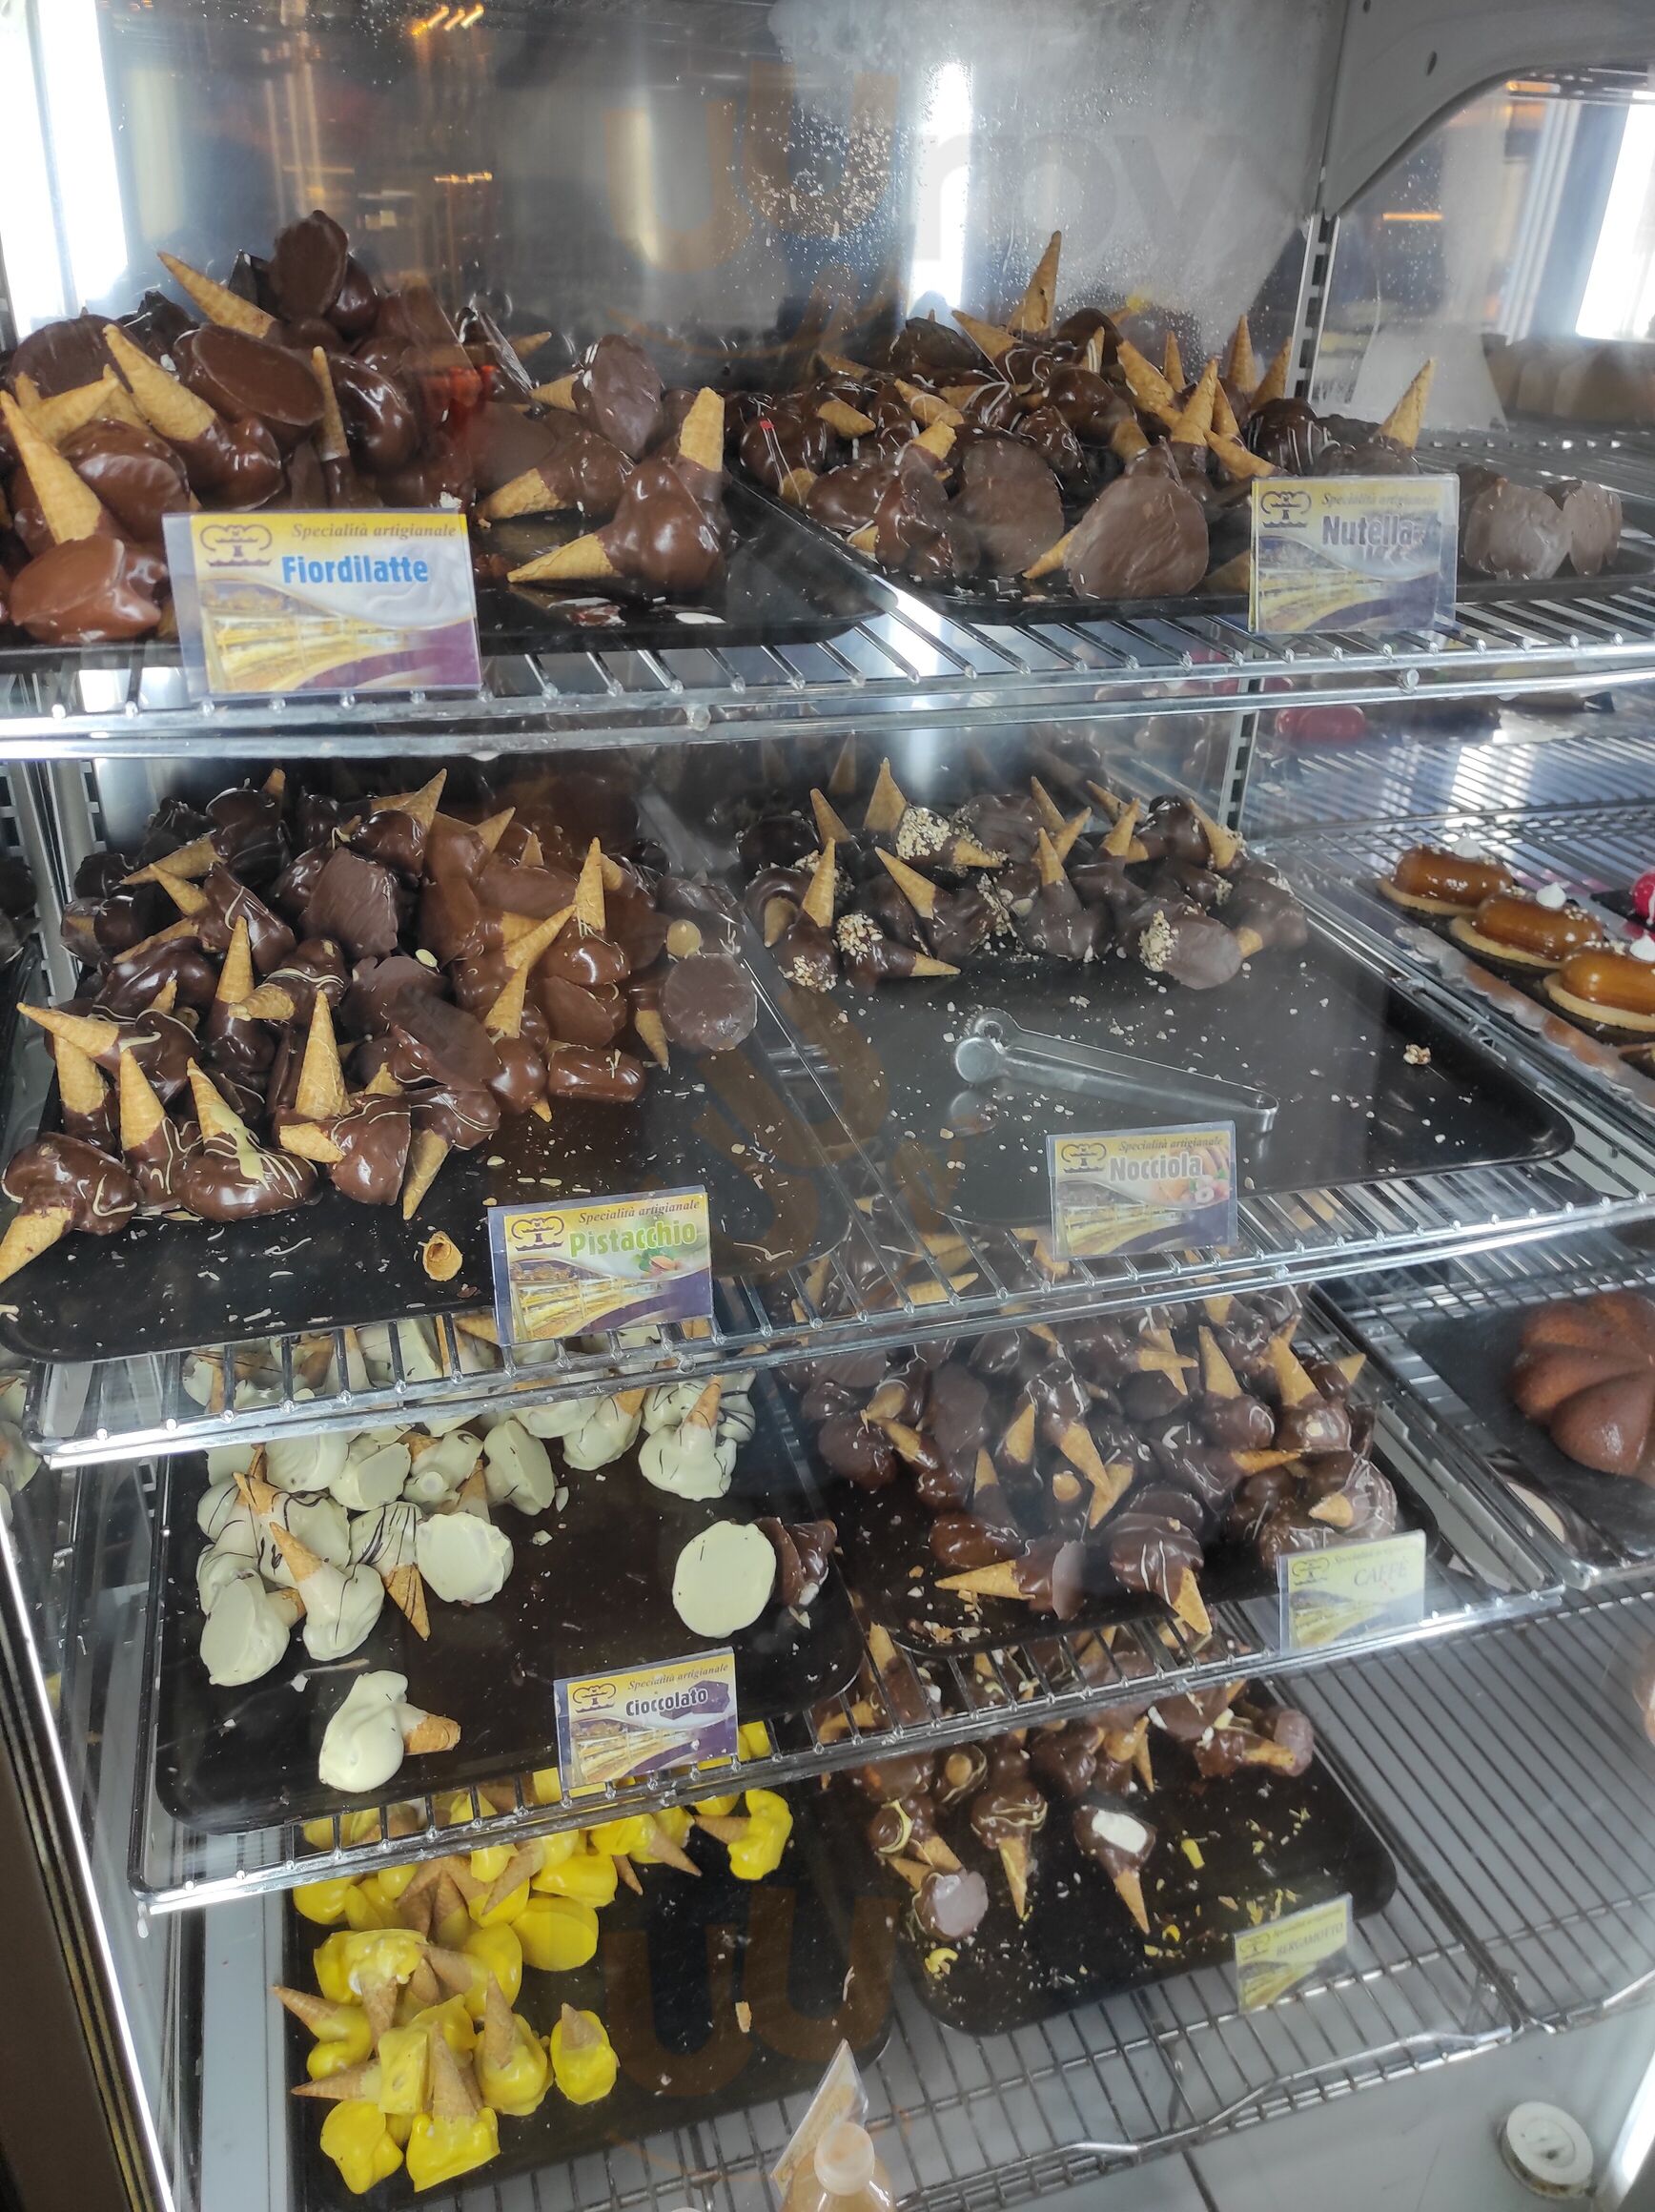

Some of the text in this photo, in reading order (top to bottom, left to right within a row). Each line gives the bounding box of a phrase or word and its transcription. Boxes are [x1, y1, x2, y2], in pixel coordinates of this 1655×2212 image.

[292, 522, 457, 541] Specialità artigianale
[1322, 515, 1414, 546] Nutella
[281, 556, 429, 584] Fiordilatte
[1118, 1136, 1223, 1155] Specialità artigianale
[1110, 1152, 1203, 1182] Nocciola
[579, 1199, 701, 1225] Specialità artigianale
[569, 1220, 697, 1259] Pistacchio
[677, 1663, 730, 1680] artigianale
[625, 1688, 708, 1717] Cioccolato
